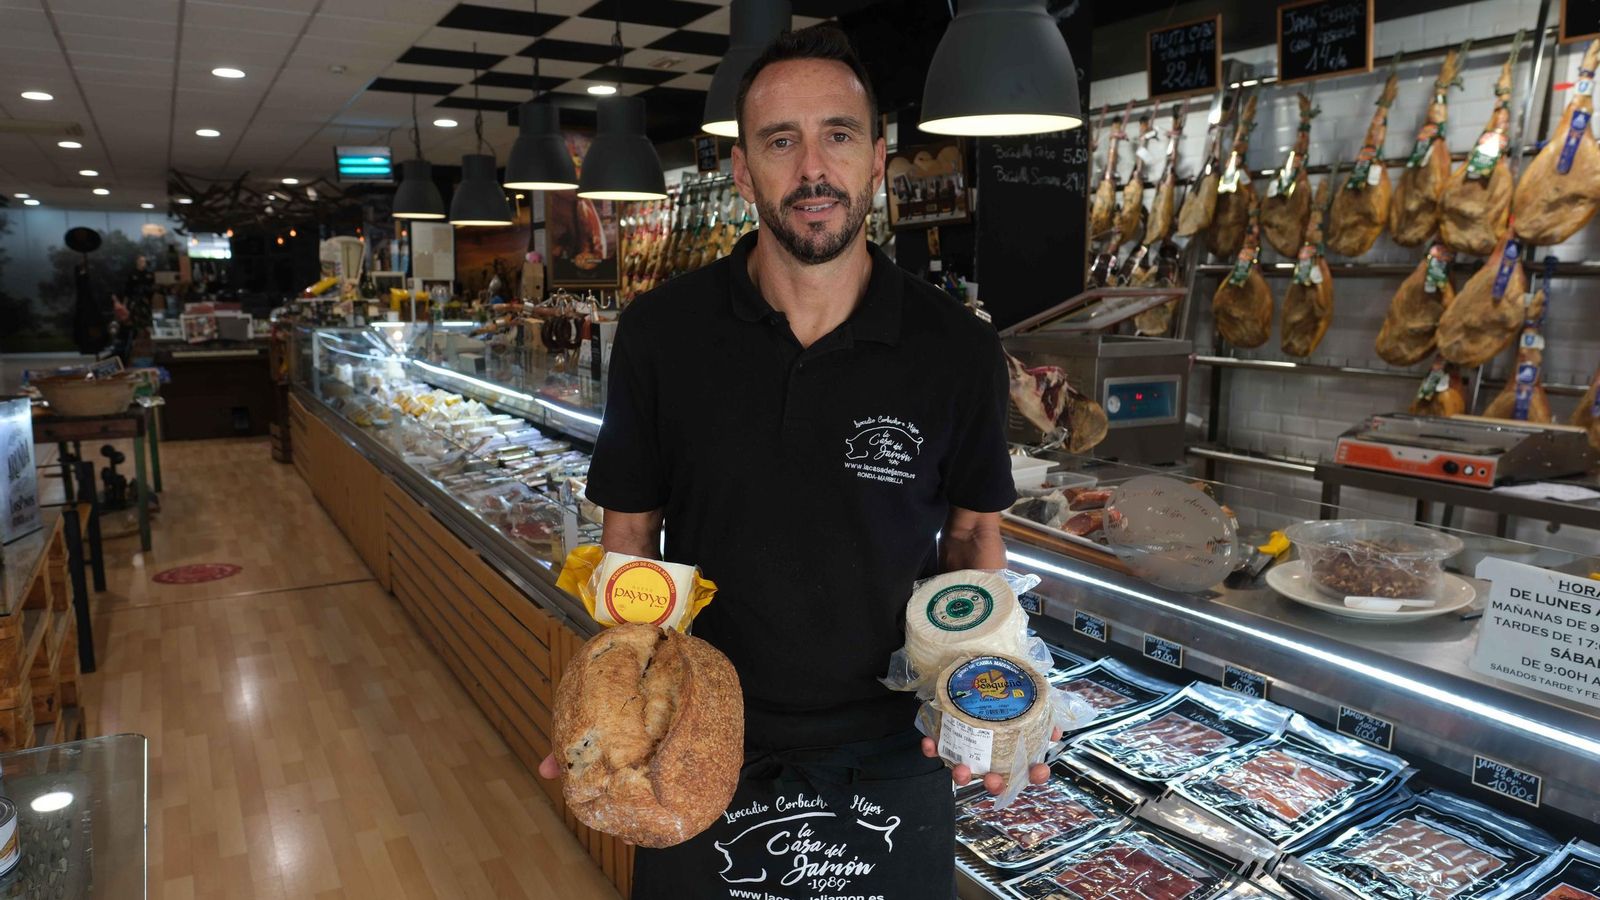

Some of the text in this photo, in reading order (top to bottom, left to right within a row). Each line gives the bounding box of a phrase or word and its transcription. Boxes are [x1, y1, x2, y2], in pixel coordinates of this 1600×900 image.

[868, 433, 895, 446] Casa
[1510, 587, 1592, 614] DE LUNES
[1492, 600, 1563, 625] MAÑANAS
[1566, 618, 1587, 631] DE
[1493, 616, 1549, 638] TARDES
[1553, 631, 1573, 644] DE
[1521, 656, 1541, 670] DE
[1544, 663, 1588, 683] 9:00H
[1550, 648, 1600, 669] SÁBA
[1490, 662, 1537, 682] SÁBADOS
[1539, 677, 1574, 693] TARDE
[1576, 687, 1583, 695] Y
[722, 800, 770, 824] Leocadio
[850, 794, 884, 816] Hijos
[766, 822, 847, 858] la Casa del
[780, 854, 876, 886] Jamón
